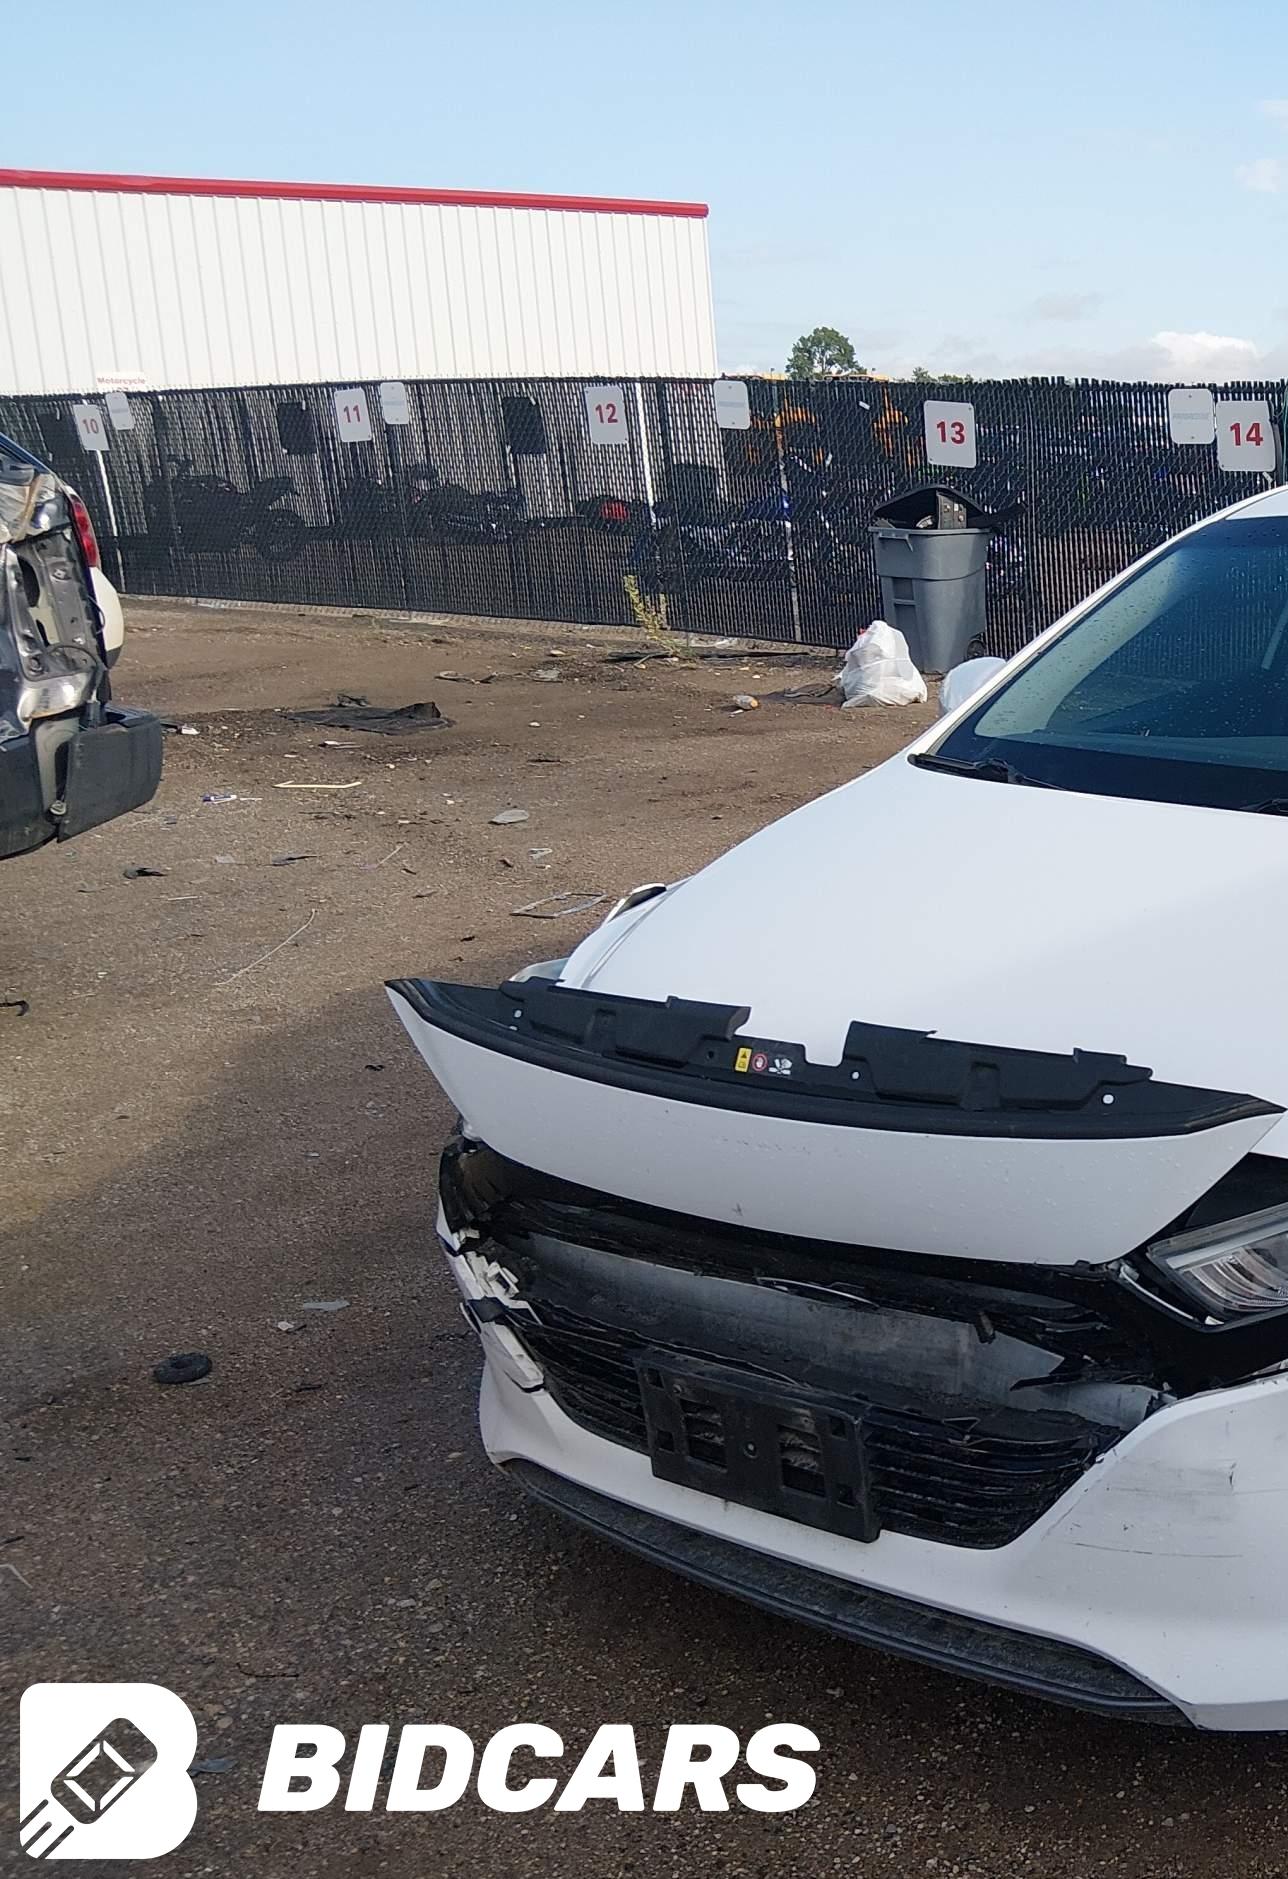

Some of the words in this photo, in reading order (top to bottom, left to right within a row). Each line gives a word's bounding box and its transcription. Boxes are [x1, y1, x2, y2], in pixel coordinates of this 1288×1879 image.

[343, 404, 361, 423] 11
[595, 403, 618, 424] 12
[82, 418, 99, 434] 10
[936, 420, 965, 445] 13
[1230, 422, 1264, 446] 14
